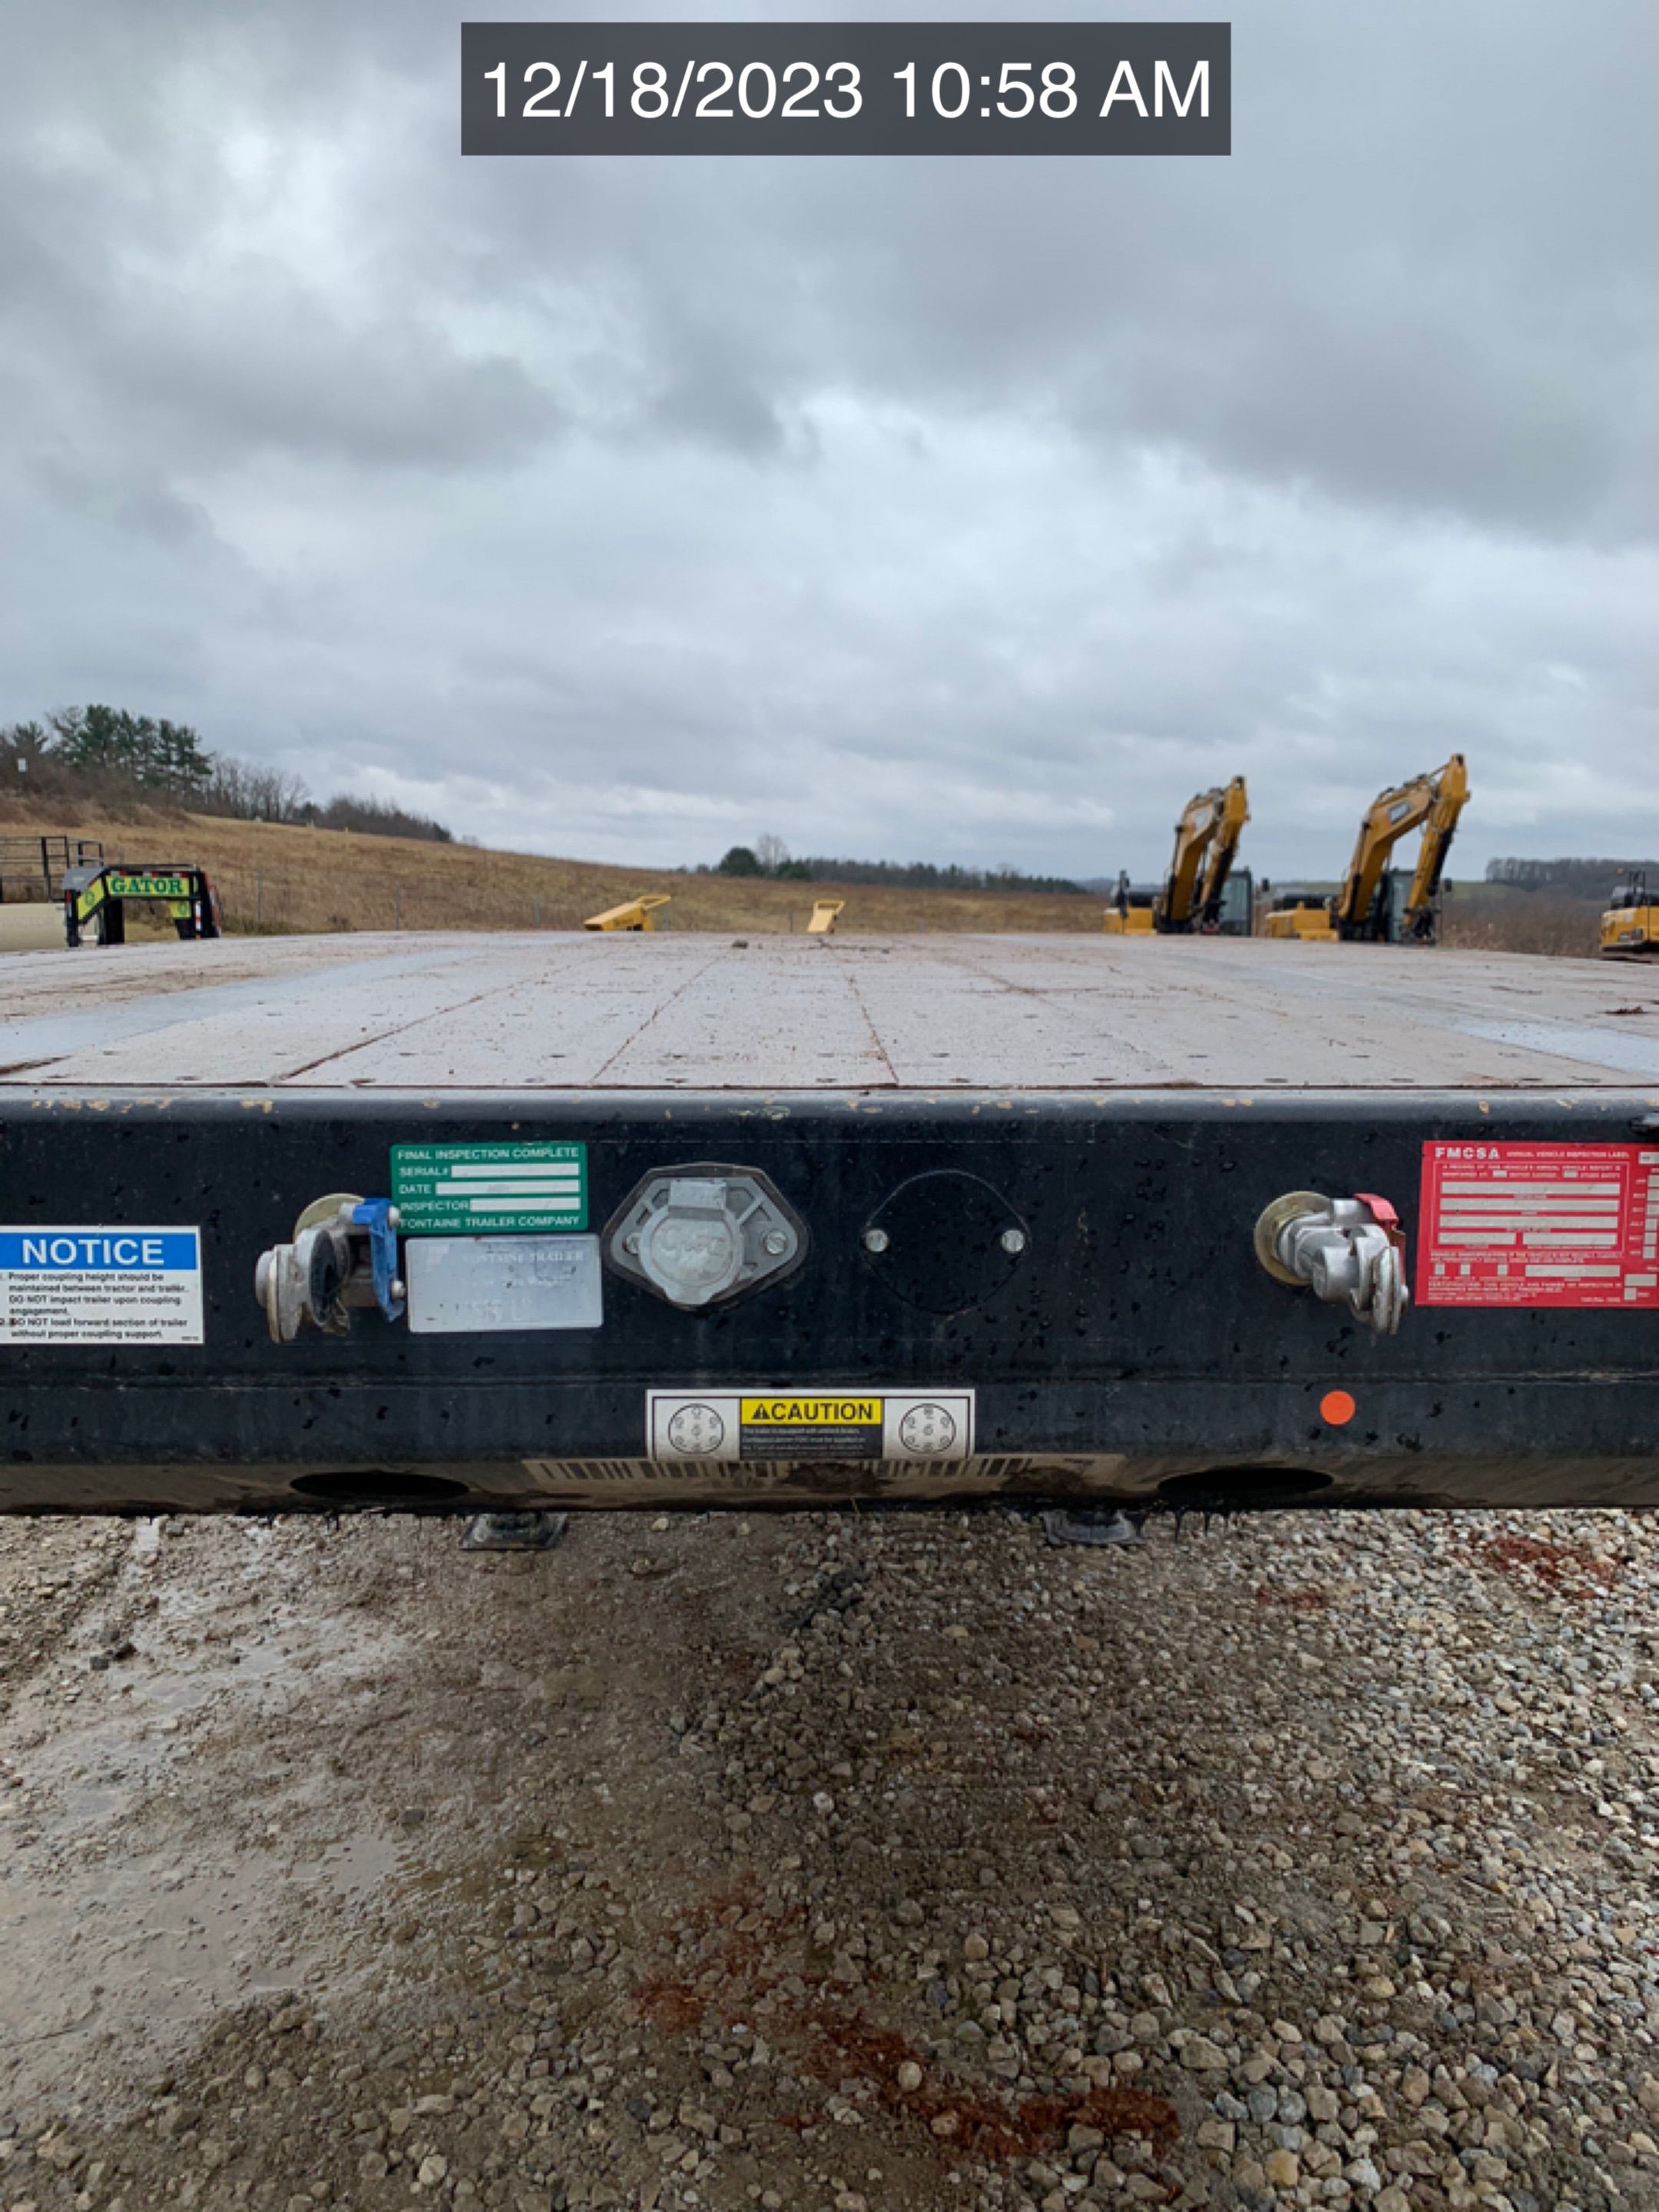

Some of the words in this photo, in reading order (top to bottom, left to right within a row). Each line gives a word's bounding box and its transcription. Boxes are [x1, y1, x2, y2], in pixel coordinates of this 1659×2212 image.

[110, 877, 184, 894] GATOR
[398, 1149, 432, 1160] FINAL
[435, 1148, 510, 1159] INSPECTION
[512, 1147, 579, 1158] COMPLETE
[1435, 1147, 1500, 1159] FMCSA
[399, 1184, 432, 1194] DATE
[401, 1200, 469, 1211] INSPECTOR
[465, 1216, 515, 1227] TRAILER
[518, 1215, 580, 1227] COMPANY
[22, 1239, 164, 1264] NOTICE
[9, 1272, 39, 1281] Proper
[41, 1273, 83, 1282] coupling
[85, 1272, 115, 1282] height
[118, 1272, 150, 1281] should
[152, 1272, 164, 1281] be
[9, 1283, 60, 1293] maintained
[62, 1283, 101, 1293] between
[104, 1284, 136, 1293] tractor
[138, 1284, 154, 1293] and
[9, 1295, 23, 1304] DO
[28, 1295, 46, 1304] NOT
[51, 1295, 81, 1304] impact
[83, 1295, 111, 1304] trailer
[113, 1296, 138, 1306] upon
[140, 1295, 181, 1306] coupling
[28, 1317, 48, 1327] NOT
[50, 1318, 71, 1327] load
[74, 1317, 108, 1327] forward
[112, 1318, 146, 1327] section
[149, 1318, 157, 1327] of
[161, 1318, 187, 1327] trailer
[12, 1330, 46, 1339] without
[48, 1330, 78, 1339] proper
[81, 1330, 123, 1339] coupling
[770, 1402, 873, 1420] CAUTION
